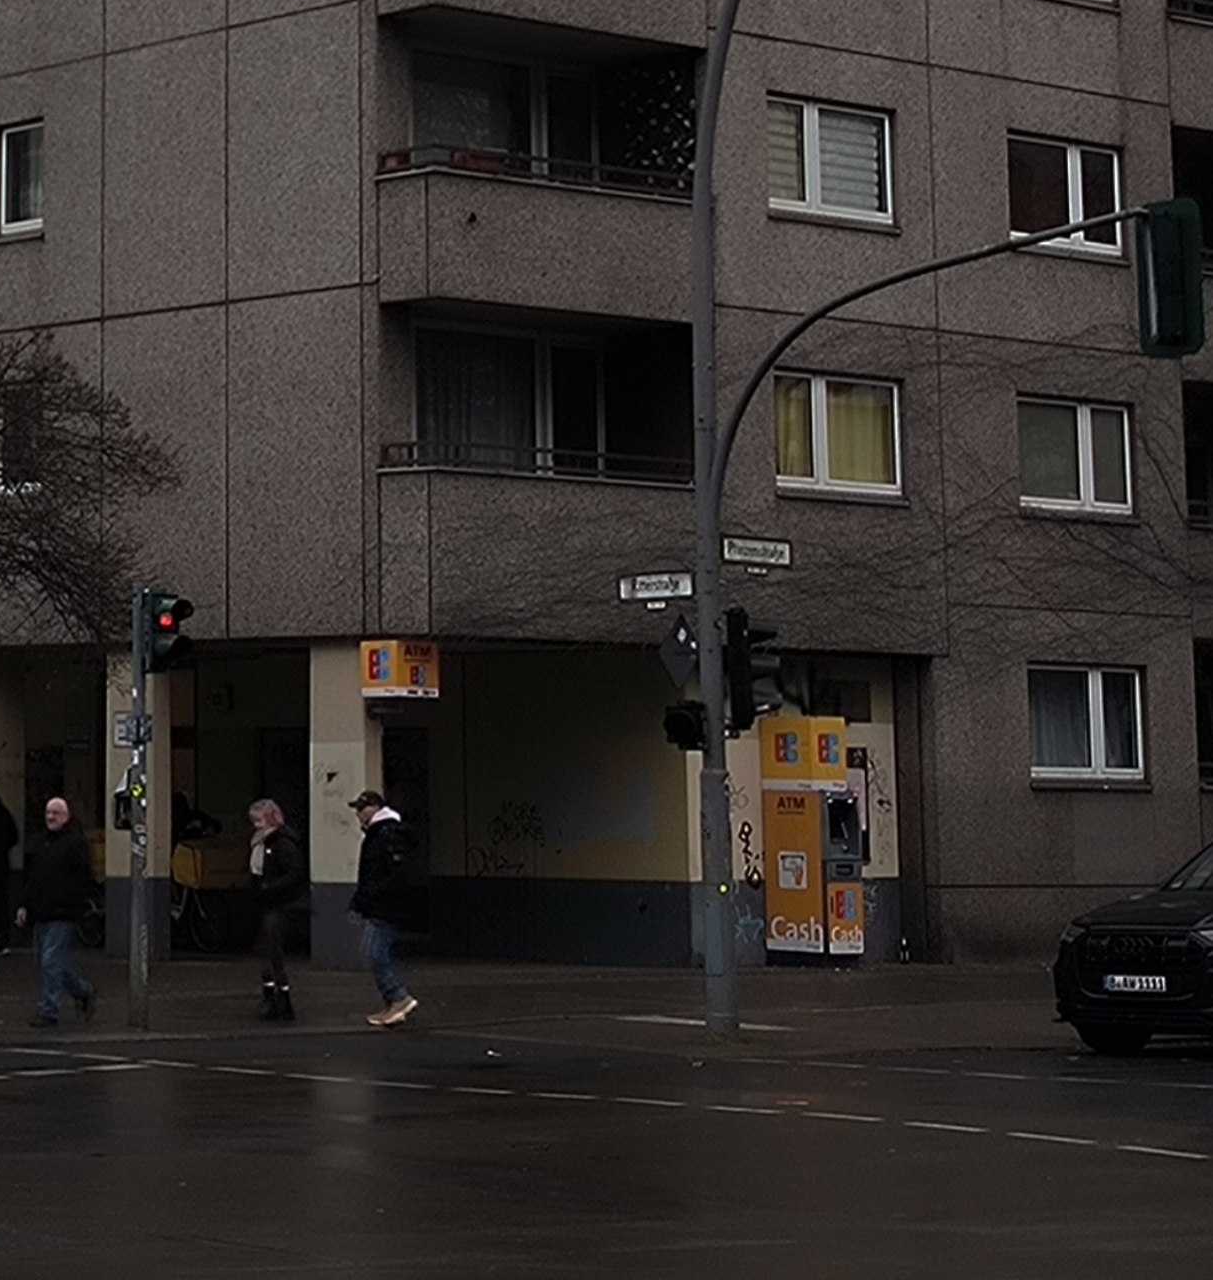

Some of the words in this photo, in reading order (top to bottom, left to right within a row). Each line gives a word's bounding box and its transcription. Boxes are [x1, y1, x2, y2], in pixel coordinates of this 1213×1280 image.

[404, 645, 432, 657] ATM
[777, 797, 805, 809] ATM
[771, 916, 823, 945] Cash
[832, 925, 863, 944] Cash
